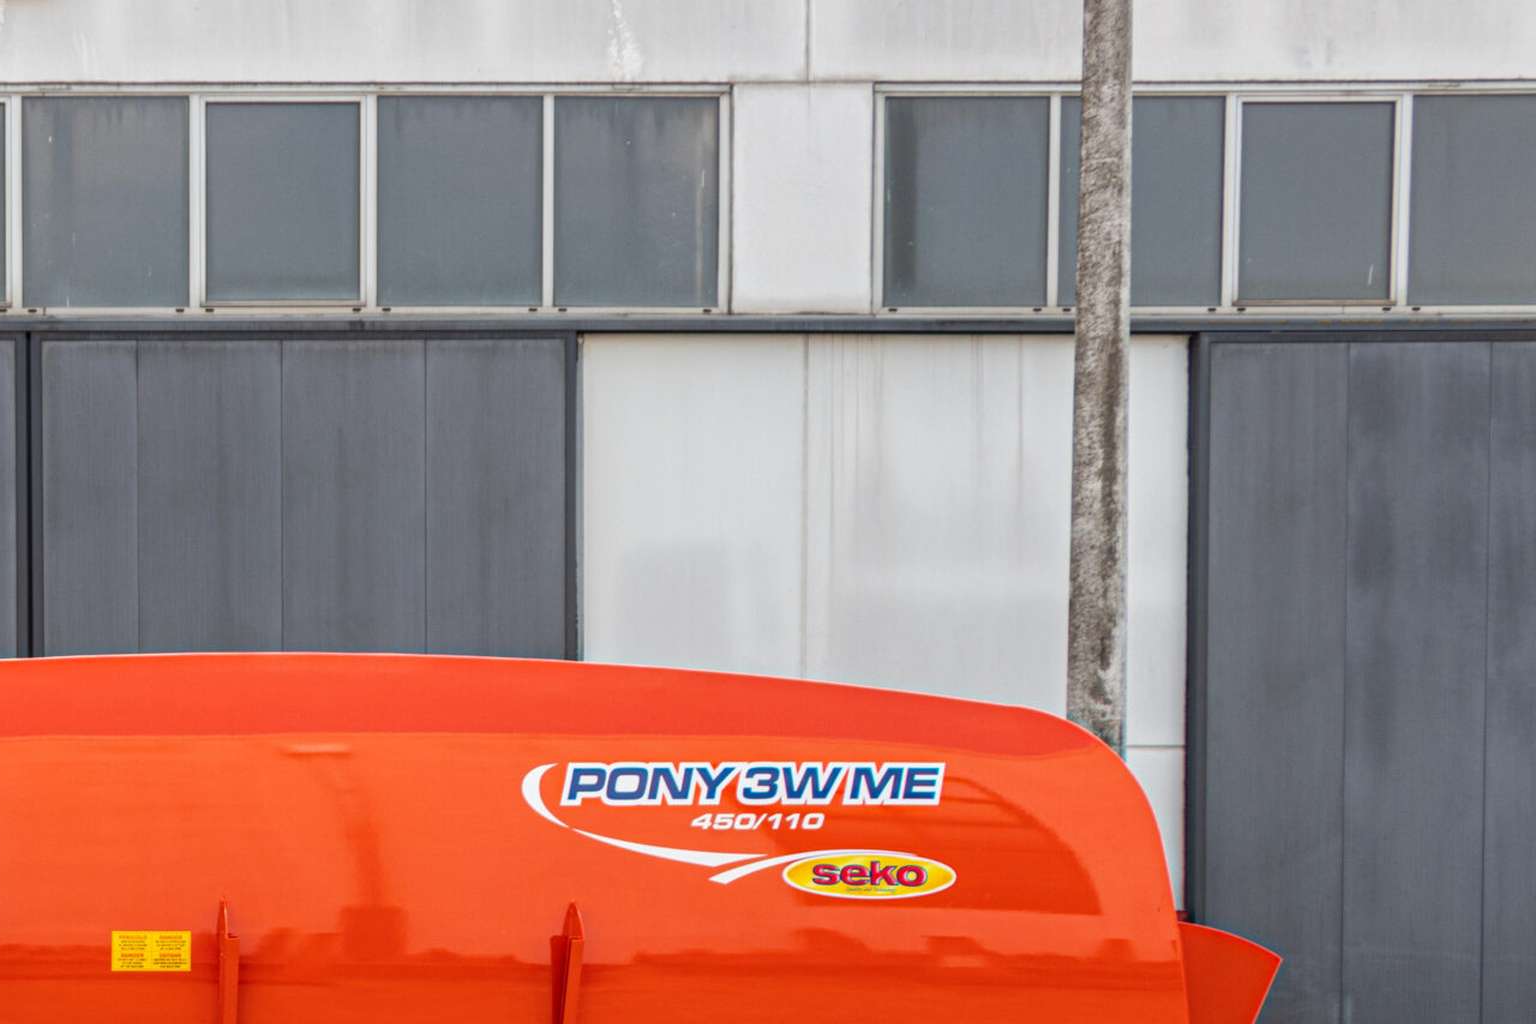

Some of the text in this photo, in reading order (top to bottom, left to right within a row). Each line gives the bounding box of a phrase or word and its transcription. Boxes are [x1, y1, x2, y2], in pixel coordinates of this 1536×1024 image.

[565, 765, 737, 802] PONY
[848, 765, 941, 801] ME
[690, 812, 825, 831] 450/110
[812, 860, 928, 887] seko
